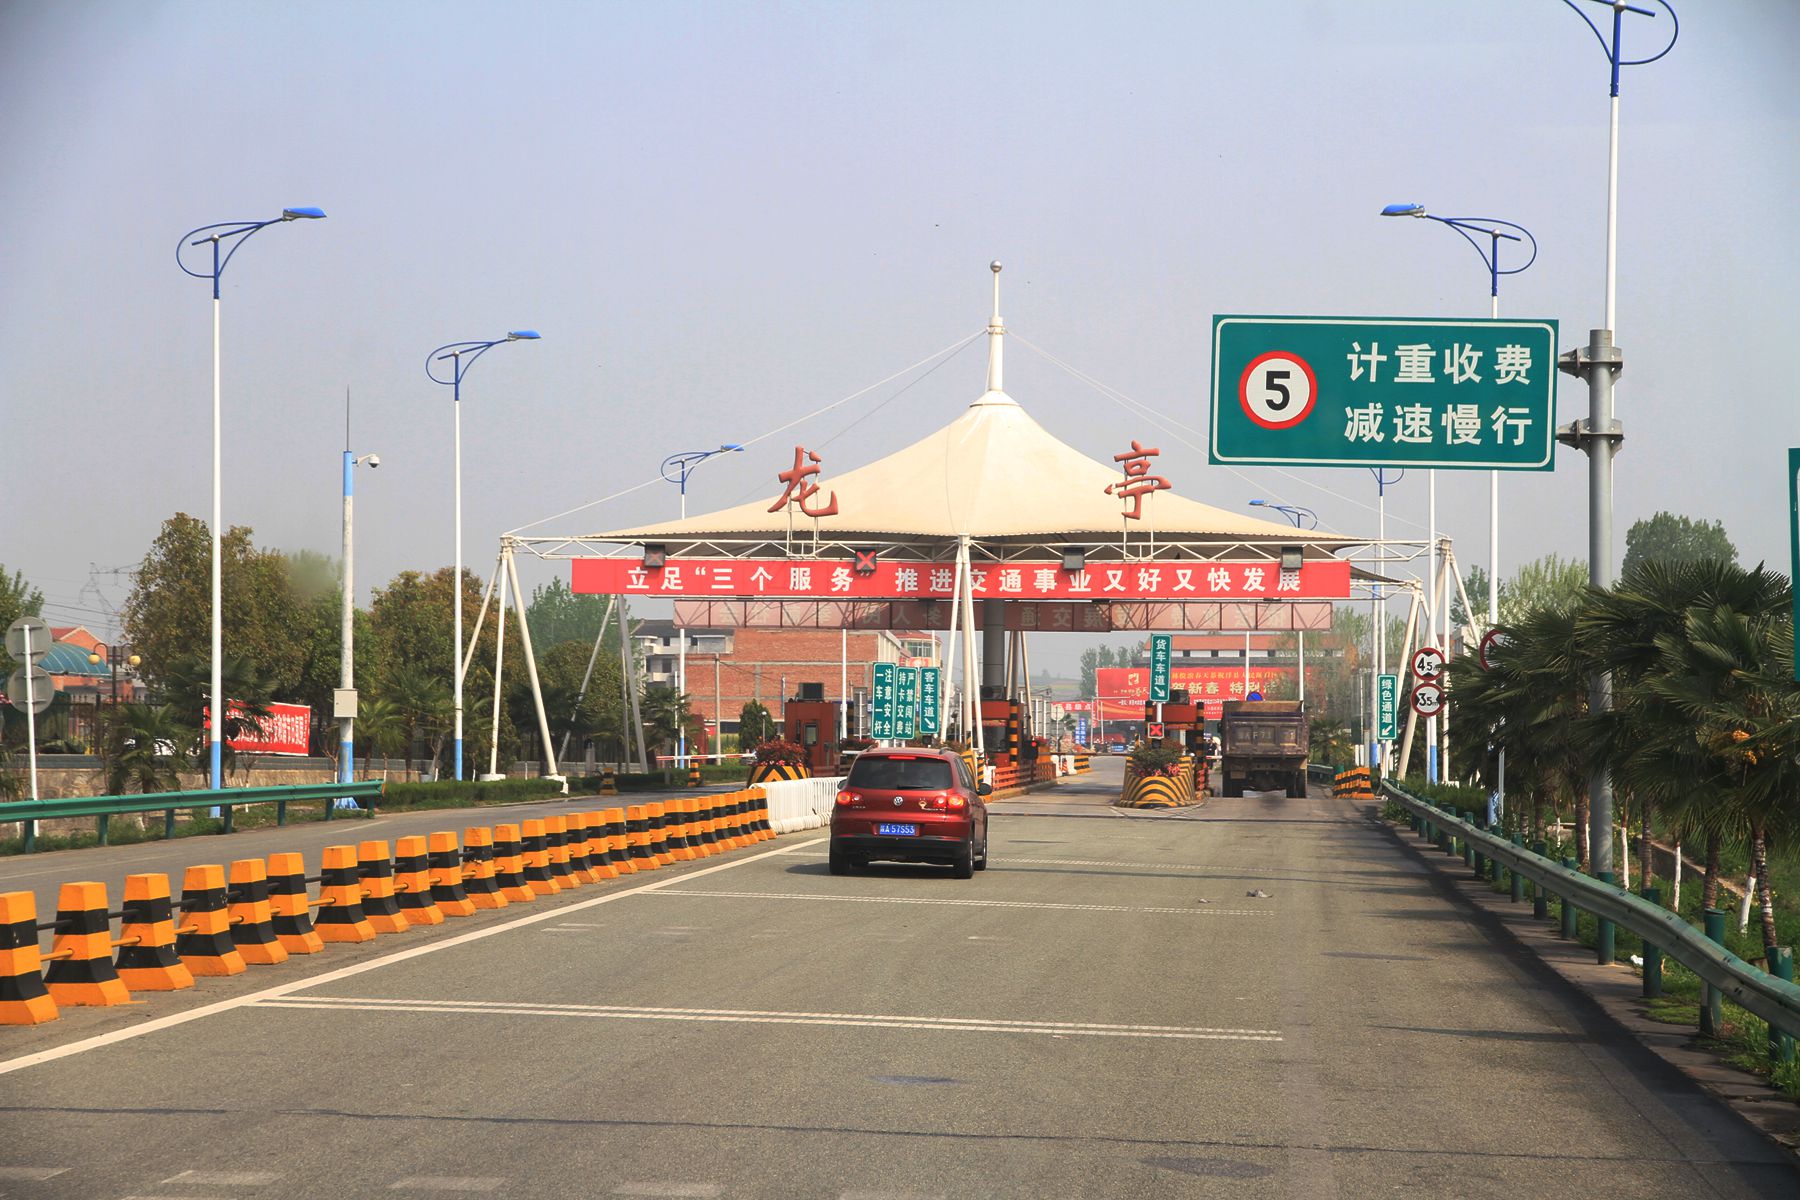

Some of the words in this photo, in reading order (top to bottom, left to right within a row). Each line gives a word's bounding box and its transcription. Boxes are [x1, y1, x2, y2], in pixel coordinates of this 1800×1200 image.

[1347, 341, 1532, 385] 计重收费
[1265, 370, 1291, 411] 5
[1344, 403, 1532, 445] 减速慢行
[1154, 639, 1167, 686] 货车车道
[874, 673, 884, 735] 一车一杆
[883, 668, 893, 735] 注意安全
[896, 671, 906, 734] 持卡交费
[905, 672, 915, 735] 严禁闯站
[923, 671, 935, 718] 客车车道
[1381, 679, 1393, 724] 绿色通道
